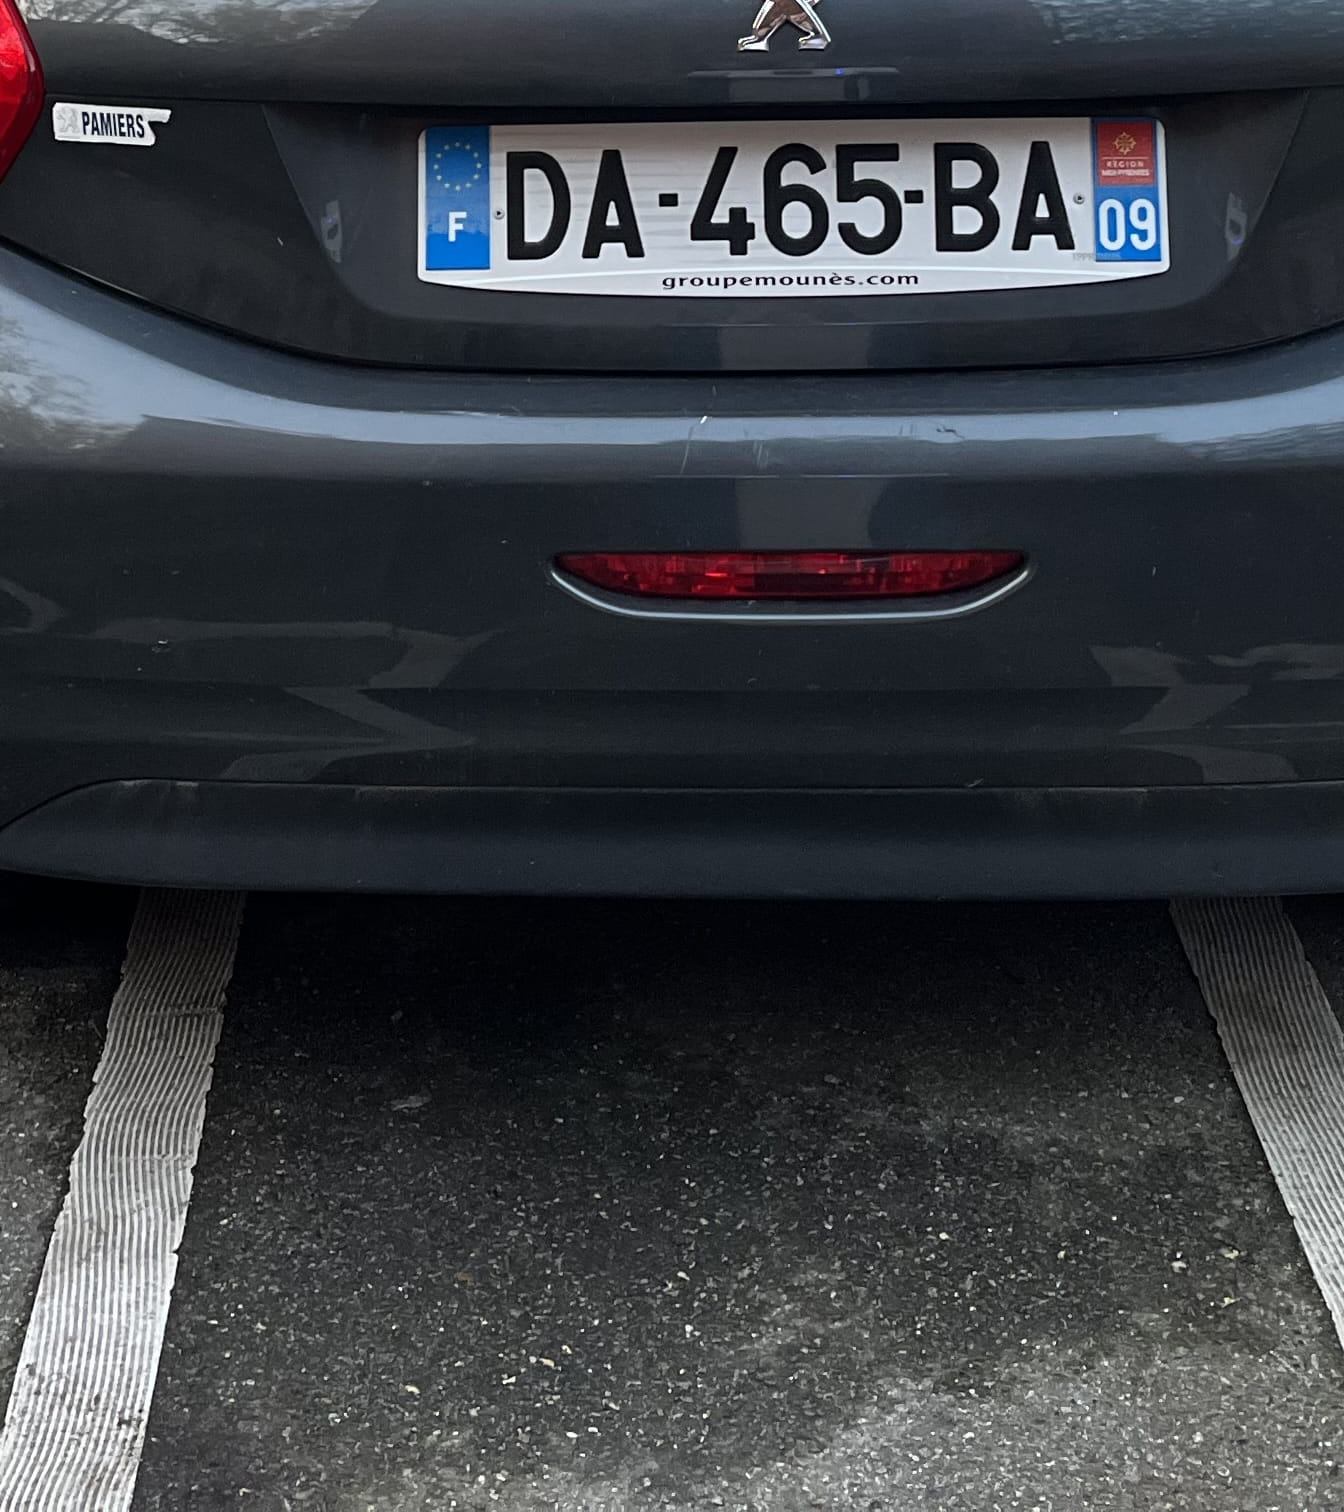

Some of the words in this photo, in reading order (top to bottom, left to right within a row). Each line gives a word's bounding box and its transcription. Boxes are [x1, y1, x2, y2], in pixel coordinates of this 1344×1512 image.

[81, 111, 145, 139] PAMIERS
[504, 140, 1077, 261] DA-465-BA
[447, 211, 468, 243] F
[1098, 198, 1157, 251] 09
[661, 272, 920, 290] groupemounès.com
